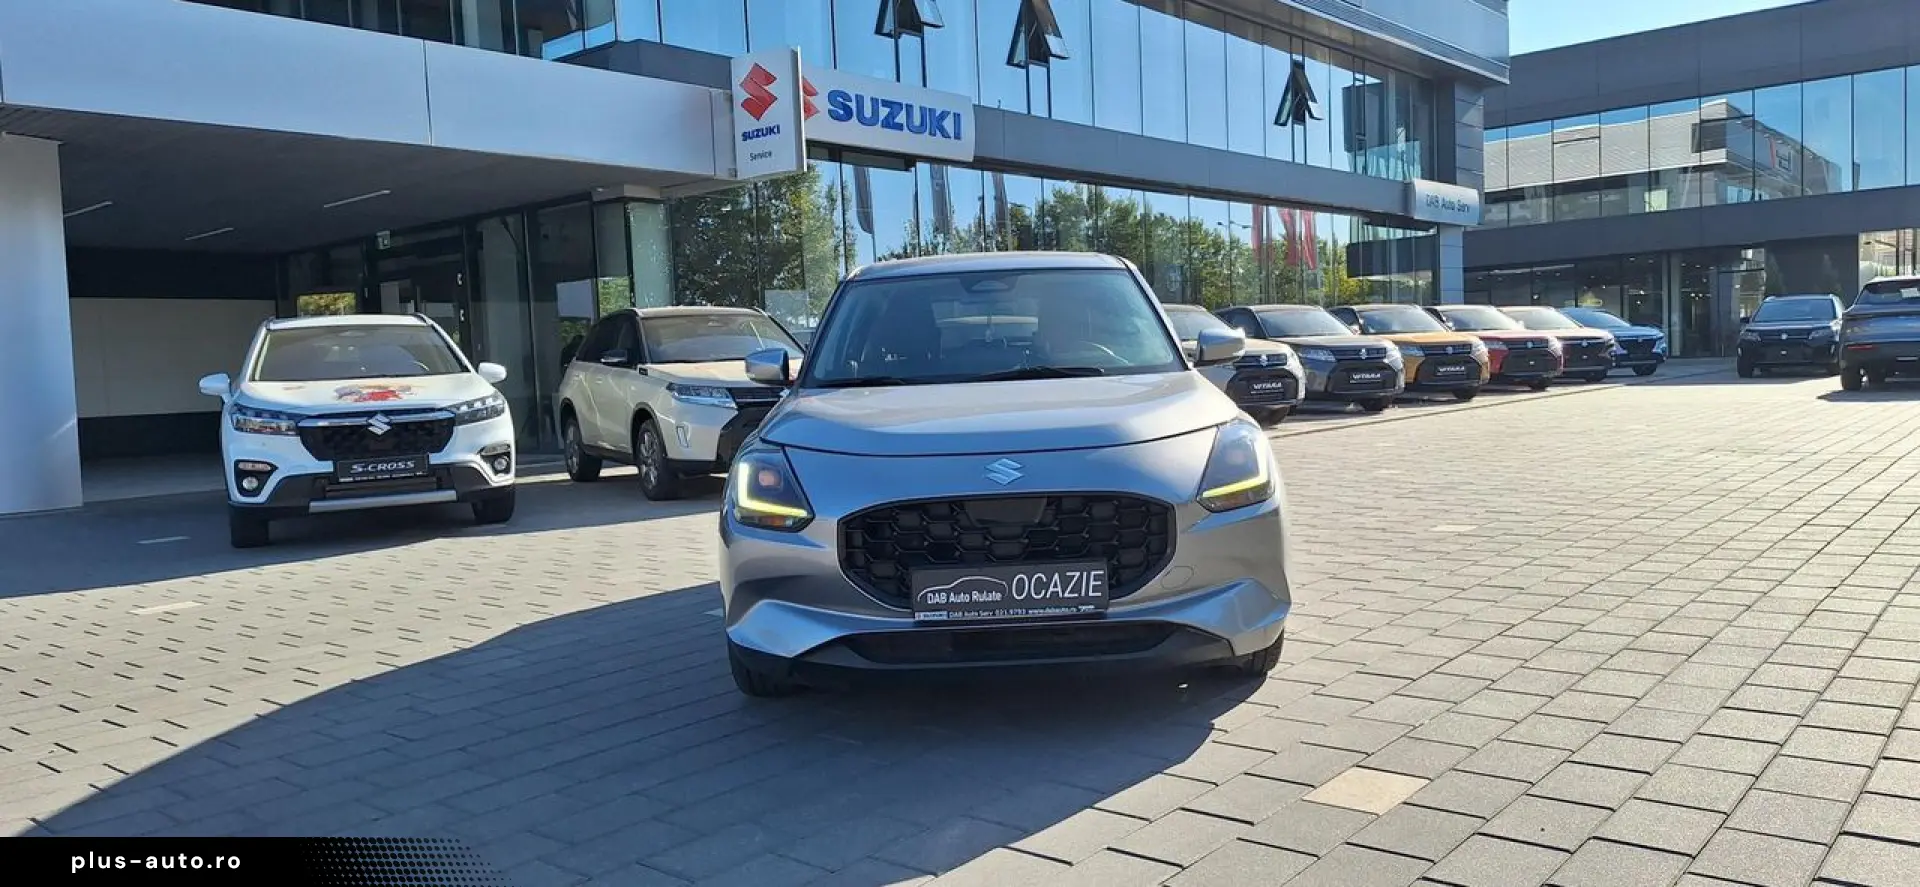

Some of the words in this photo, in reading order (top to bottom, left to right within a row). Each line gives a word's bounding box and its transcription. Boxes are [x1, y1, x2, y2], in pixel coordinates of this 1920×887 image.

[827, 89, 961, 140] SUZUKI
[741, 124, 781, 142] SUZUKI
[749, 151, 772, 161] Service
[1441, 197, 1455, 211] Auto
[1011, 569, 1105, 600] OCAZIE
[926, 592, 947, 604] DAB
[949, 591, 970, 603] Auto
[971, 590, 1003, 602] Rulate
